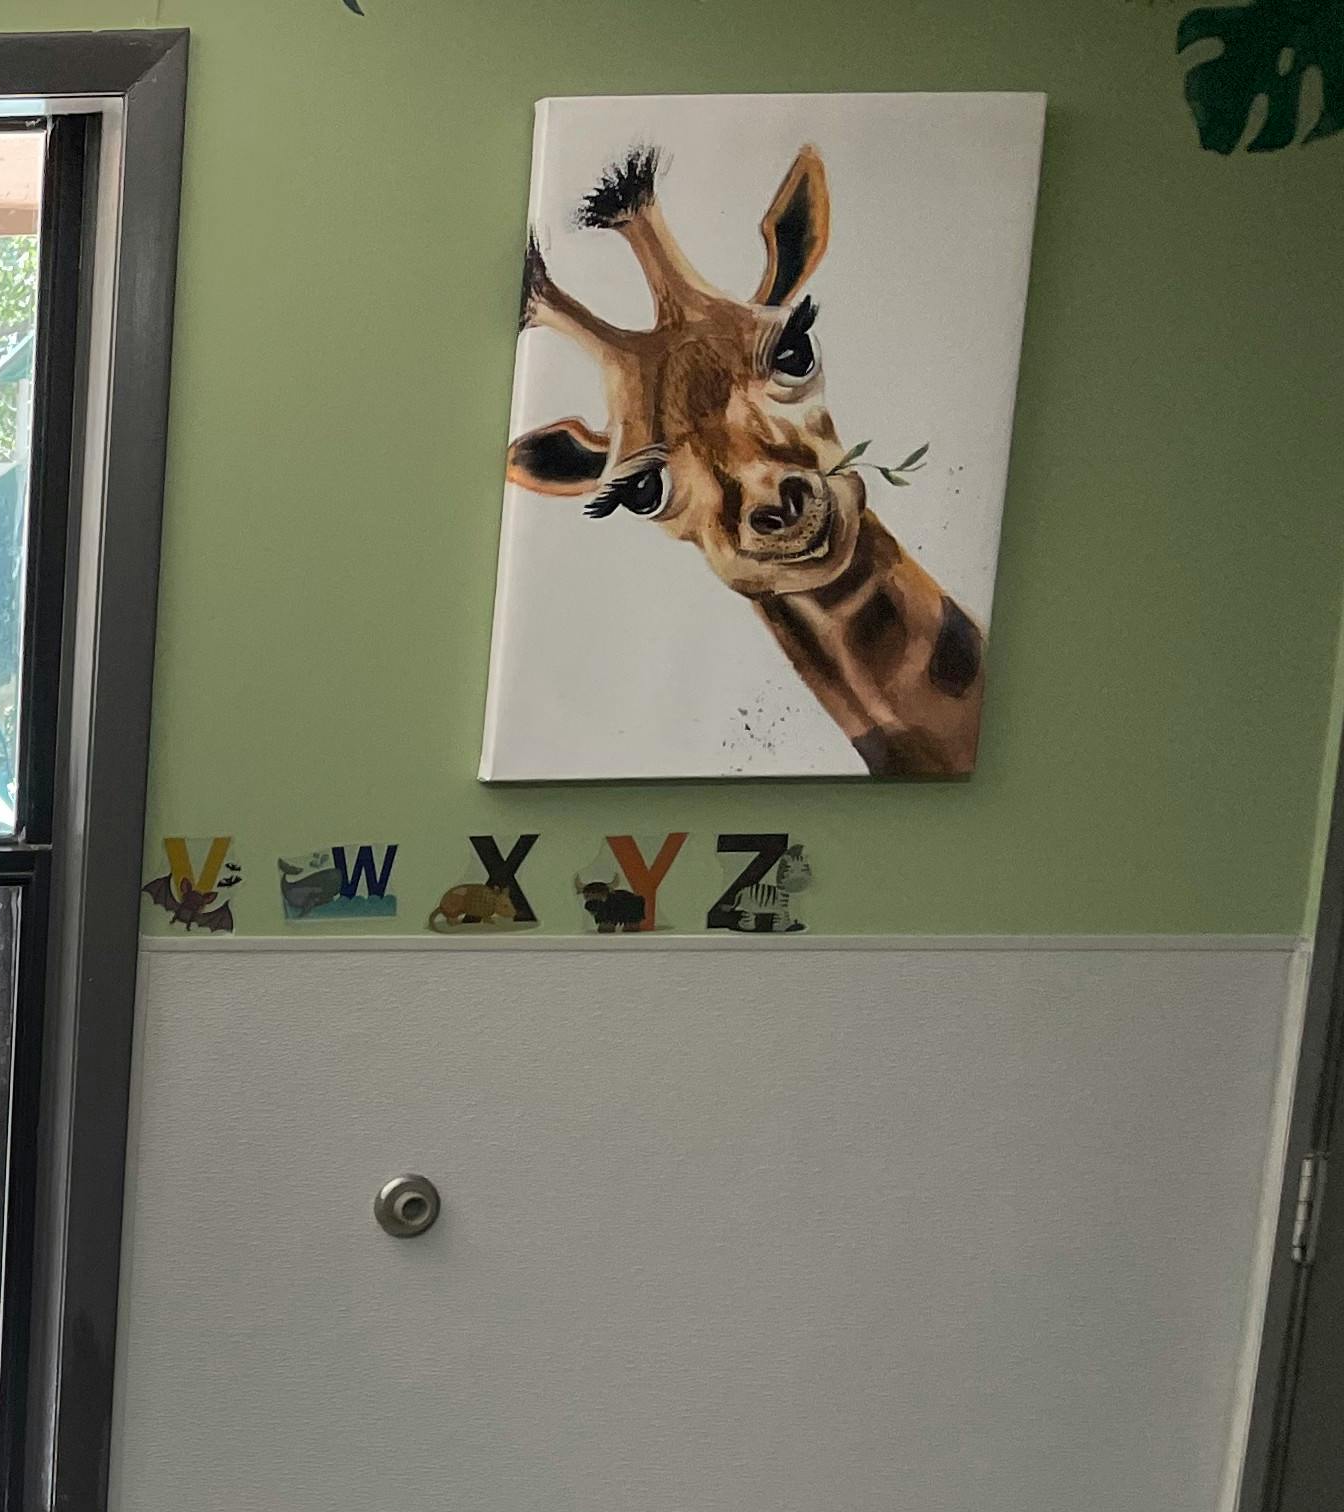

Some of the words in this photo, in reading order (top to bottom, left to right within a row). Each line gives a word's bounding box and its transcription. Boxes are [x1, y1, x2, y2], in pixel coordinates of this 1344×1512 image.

[163, 836, 232, 903] V
[330, 844, 399, 902] W
[461, 833, 541, 924] X
[605, 832, 690, 932] Y
[707, 833, 796, 931] Z
